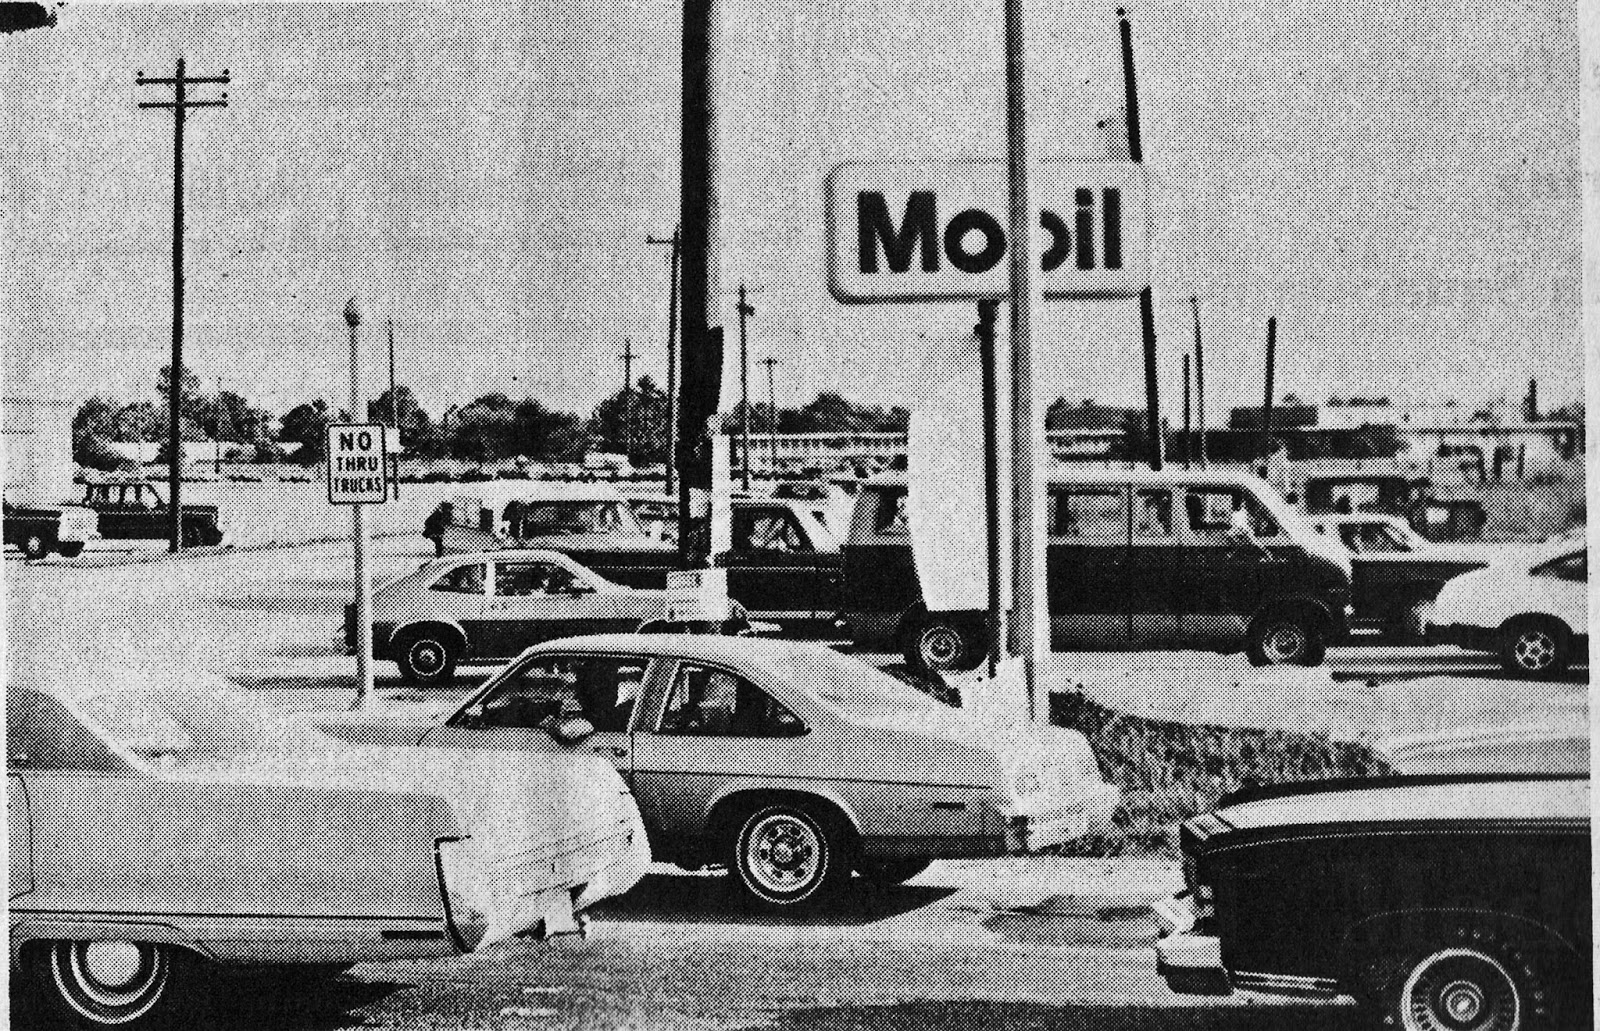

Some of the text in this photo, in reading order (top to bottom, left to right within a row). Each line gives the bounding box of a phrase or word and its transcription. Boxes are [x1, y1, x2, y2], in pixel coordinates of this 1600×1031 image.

[340, 431, 372, 451] NO
[336, 456, 378, 472] THRU
[334, 477, 382, 493] TRUCKS
